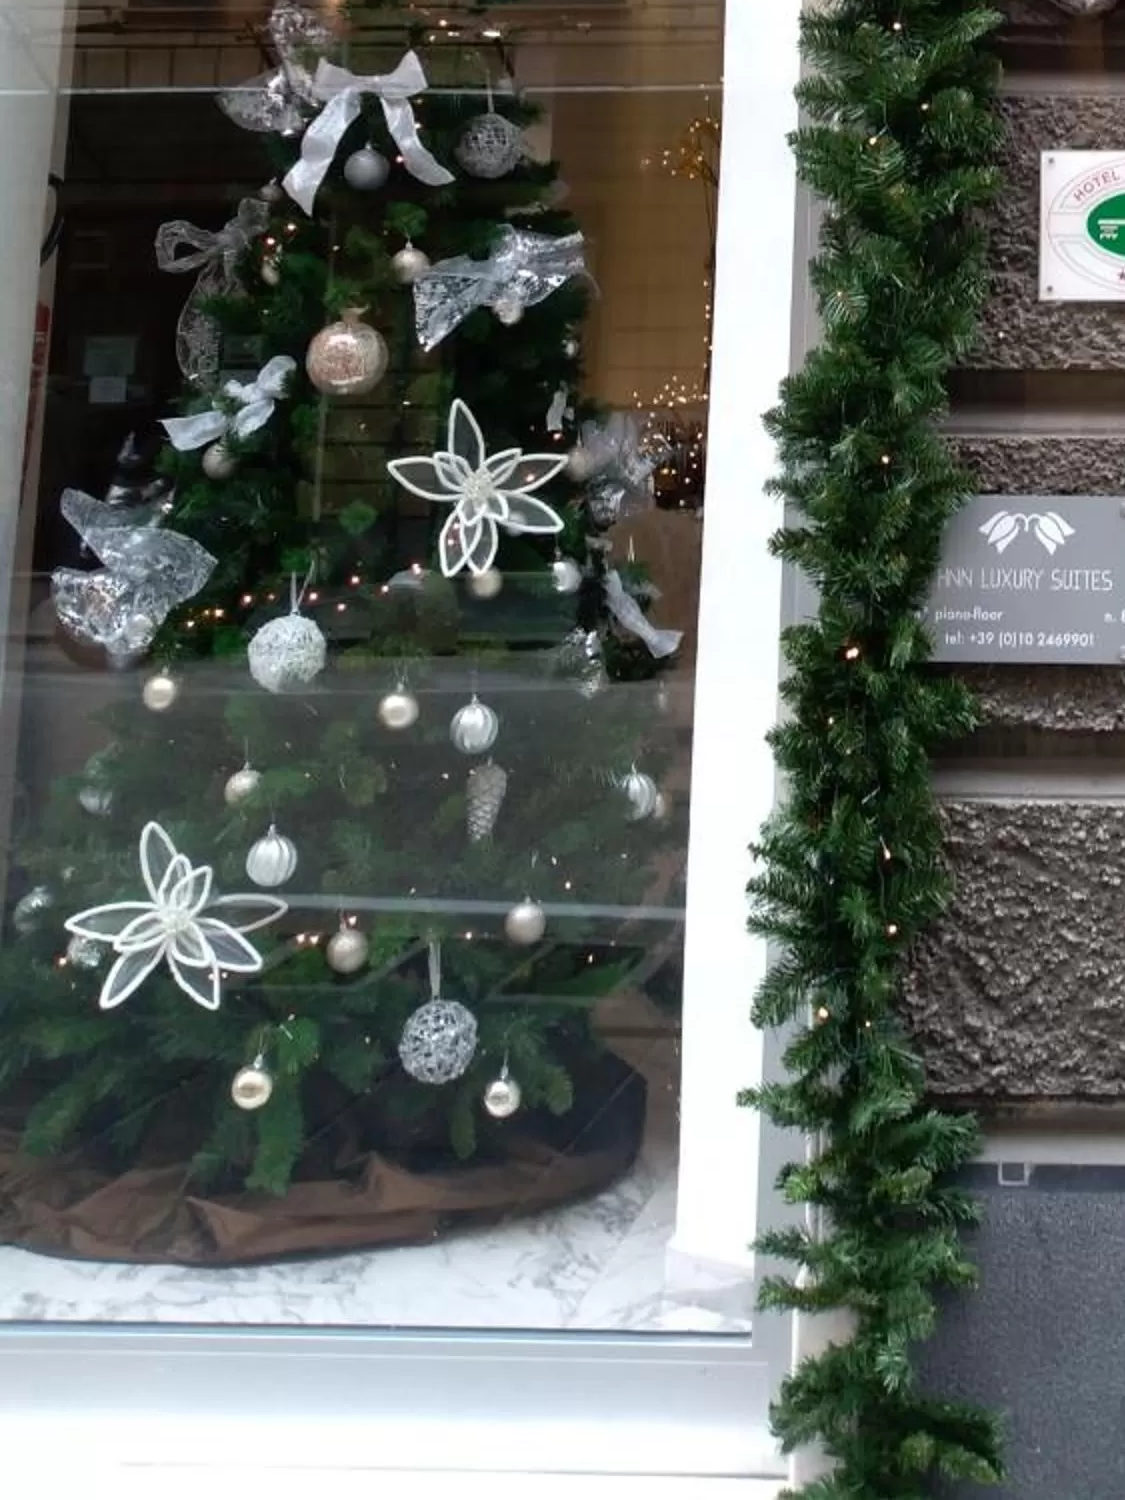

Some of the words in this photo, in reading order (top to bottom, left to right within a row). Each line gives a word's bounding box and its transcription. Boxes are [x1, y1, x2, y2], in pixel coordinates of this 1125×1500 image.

[1072, 169, 1122, 203] HOTEL
[980, 567, 1044, 591] LUXURY
[1050, 569, 1114, 592] SUITES
[970, 631, 995, 646] +39
